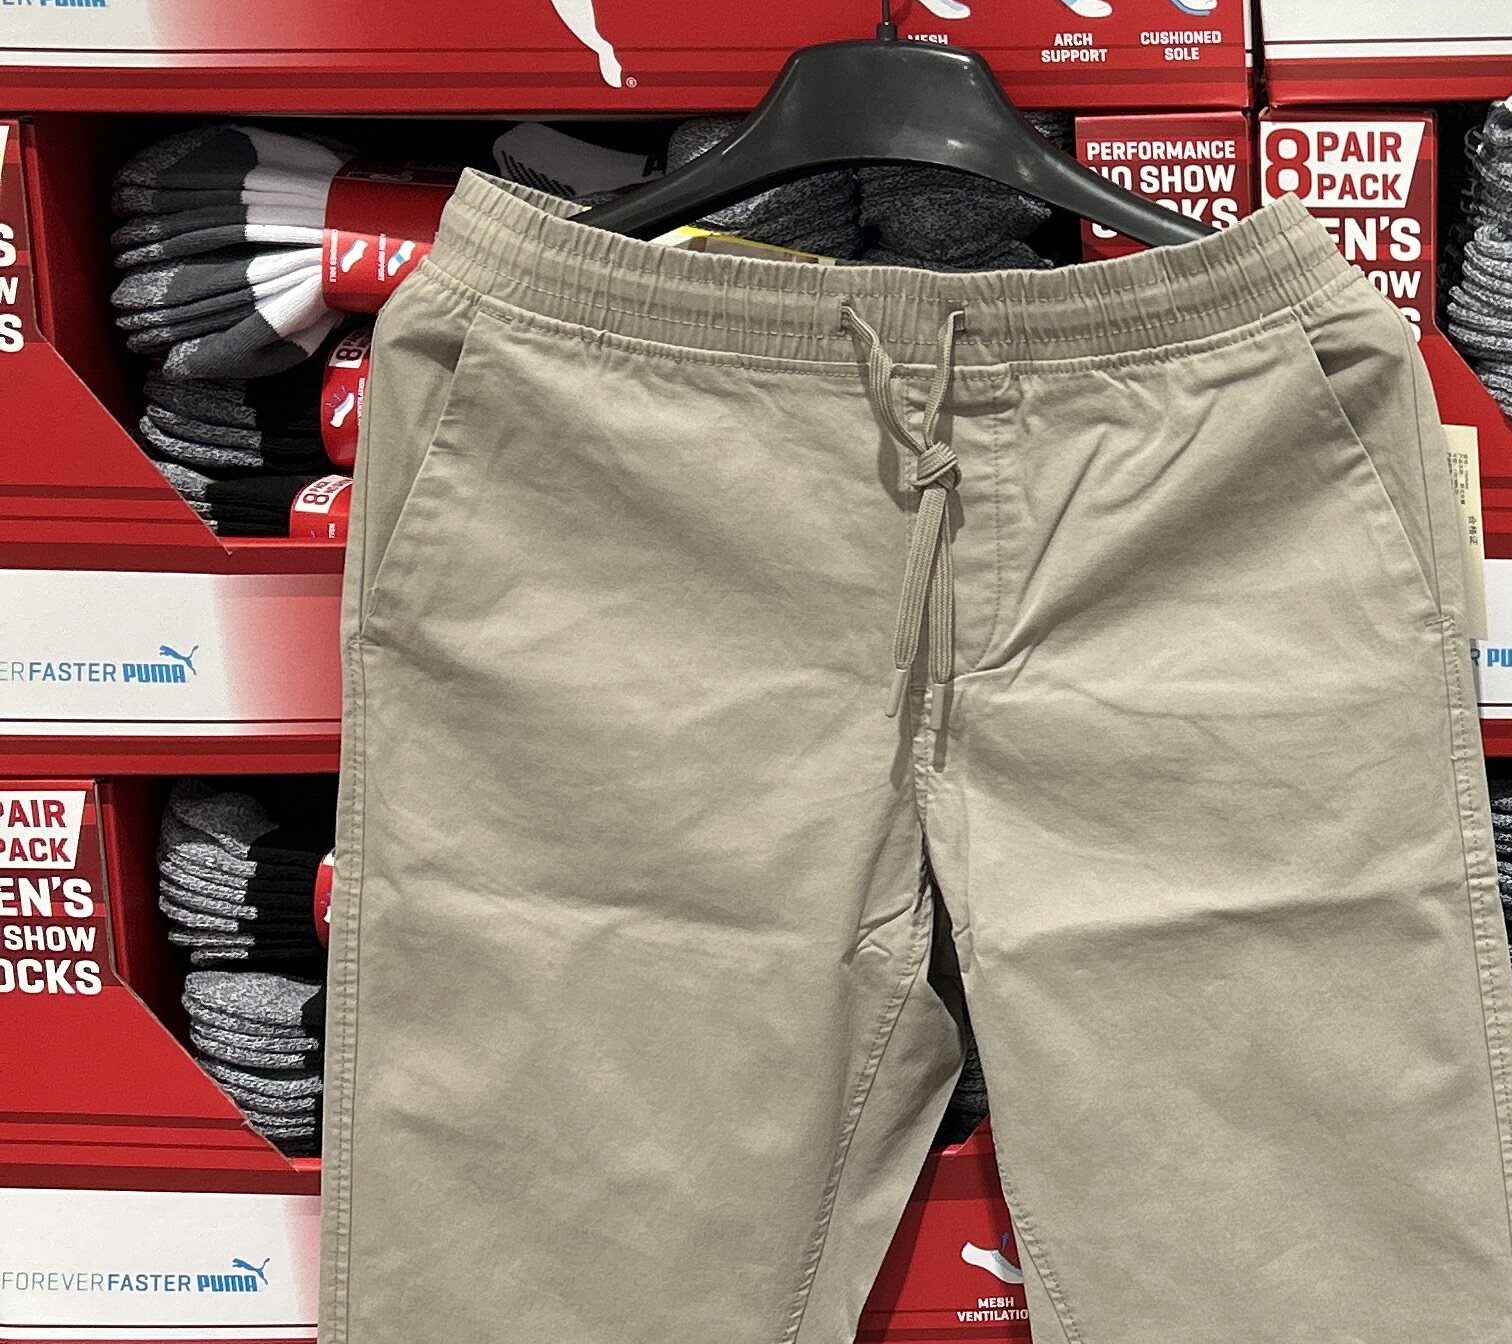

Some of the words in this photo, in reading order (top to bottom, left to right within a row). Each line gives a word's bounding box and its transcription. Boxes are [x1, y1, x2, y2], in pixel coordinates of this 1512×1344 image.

[1054, 33, 1093, 47] ARCH
[1140, 31, 1222, 46] CUSHIONED
[1041, 49, 1108, 63] SUPPORT
[1164, 47, 1200, 61] SOLE
[1086, 140, 1235, 161] PERFORMANCE
[1265, 128, 1312, 200] 8
[1316, 131, 1403, 163] PAIR
[1139, 163, 1236, 193] SHOW
[1317, 173, 1403, 201] PACK
[303, 492, 329, 507] 8
[122, 663, 187, 683] PUMA
[0, 799, 67, 828] AIR
[0, 877, 94, 918] EN'S
[3, 925, 96, 952] SHOW
[0, 958, 102, 995] OCKS
[197, 1274, 258, 1293] PUMA
[978, 1297, 1015, 1308] MESH
[956, 1309, 1029, 1322] VENTILATIO
